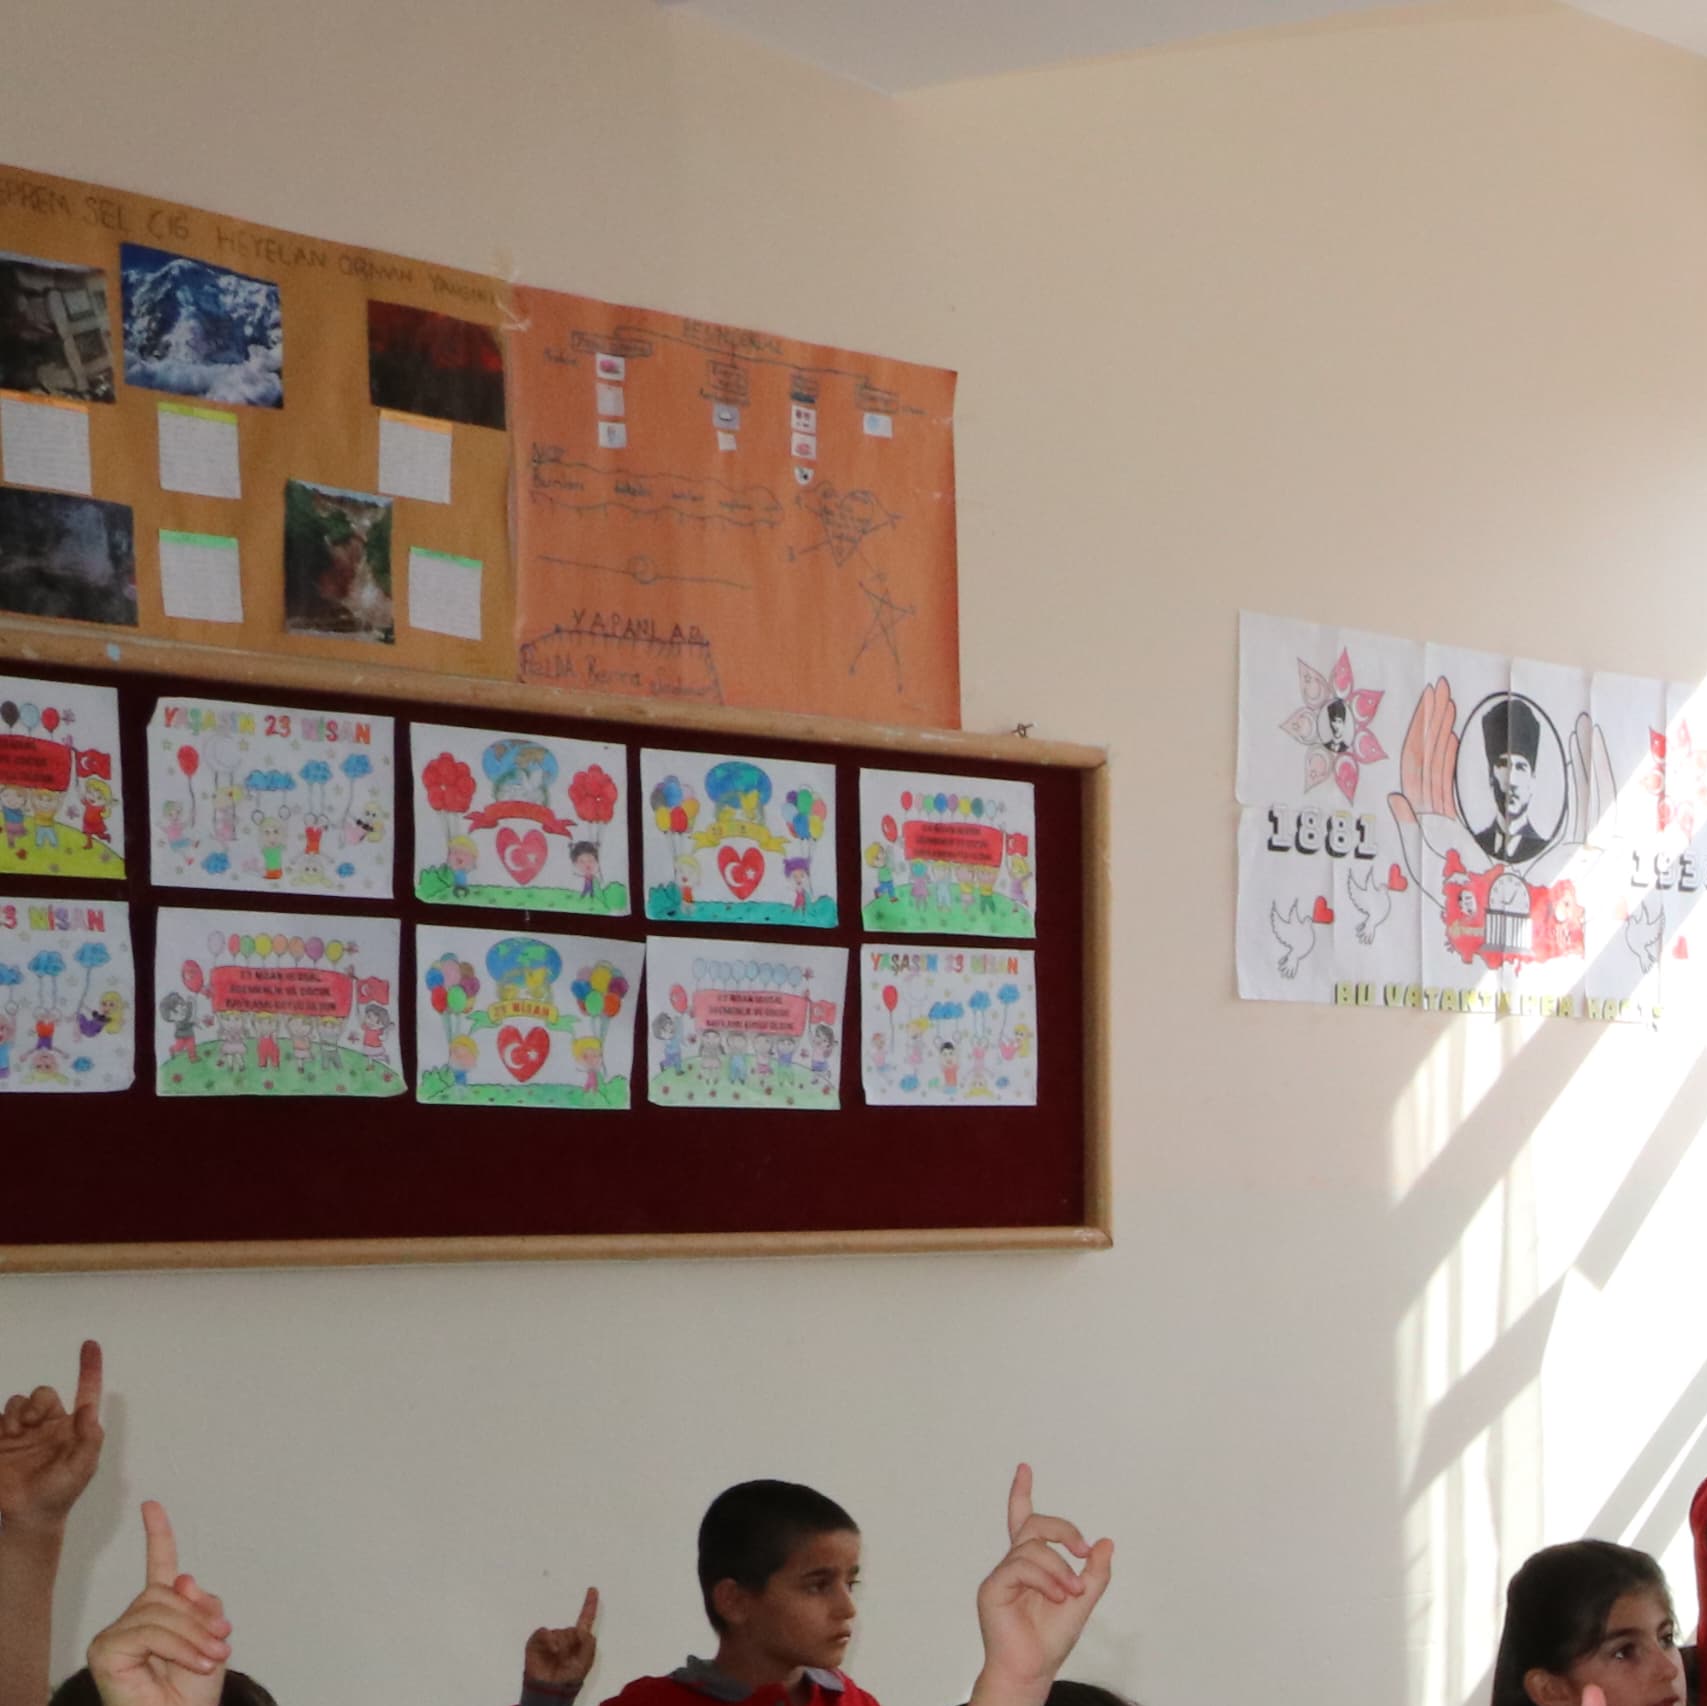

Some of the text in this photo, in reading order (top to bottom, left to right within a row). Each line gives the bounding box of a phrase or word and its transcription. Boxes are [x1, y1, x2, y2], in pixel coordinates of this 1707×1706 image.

[264, 714, 292, 737] 23
[1267, 801, 1378, 860] 1881
[1334, 981, 1376, 1008] BU
